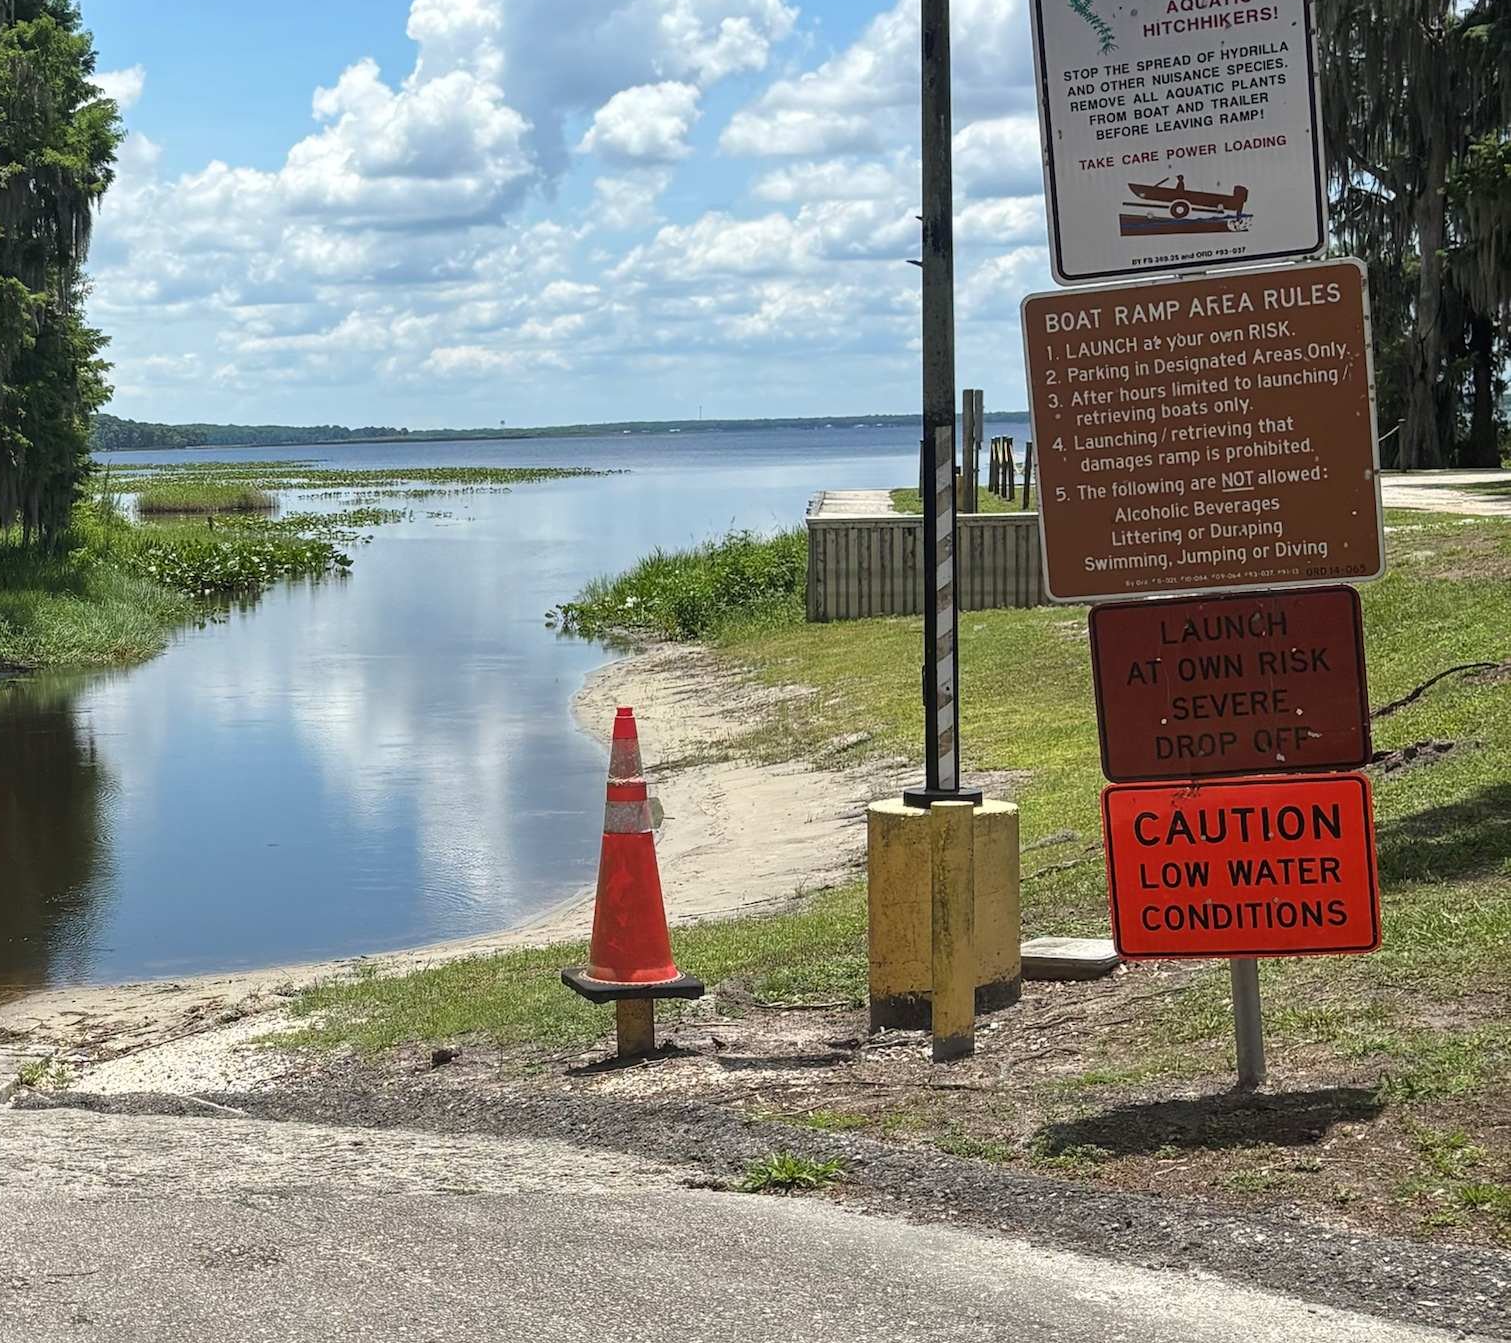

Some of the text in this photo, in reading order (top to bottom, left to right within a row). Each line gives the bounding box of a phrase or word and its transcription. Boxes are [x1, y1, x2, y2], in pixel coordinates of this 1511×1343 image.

[1143, 7, 1279, 37] HITCHHIKERS!
[1064, 41, 1289, 82] STOP THE SPREAD OF HYDRILLA
[1068, 59, 1288, 97] AND OTHER NUISANCE SPECIES.
[1070, 74, 1286, 111] REMOVE ALL AQUATIC PLANTS
[1090, 92, 1269, 125] FROM BOAT AND TRAILER
[1096, 110, 1264, 140] BEFORE LEAVING RAMP!
[1080, 135, 1286, 170] TAKE CARE POWER LOADING
[1045, 283, 1341, 333] BOAT RAMP AREA RULES
[1047, 322, 1295, 360] 1. LAUNCH at your own RISK.
[1046, 342, 1350, 385] 2. Parking in Designated Areas Only.
[1049, 393, 1063, 407] 3.
[1071, 390, 1113, 407] After
[1120, 385, 1166, 402] hours
[1172, 379, 1227, 397] limited
[1234, 376, 1251, 390] to
[1258, 368, 1338, 392] launching
[1077, 398, 1253, 427] retrieving boats only.
[1052, 437, 1066, 452] 4.
[1258, 417, 1293, 432] that
[1081, 439, 1313, 473] damages ramp is prohibited.
[1056, 467, 1328, 501] 5. The following are NOT allowed:
[1115, 497, 1280, 523] Alcoholic Beverages
[1112, 527, 1182, 546] Littering
[1188, 527, 1205, 540] or
[1084, 542, 1328, 571] Swimming, Jumping or Diving
[1161, 613, 1288, 644] LAUNCH
[1127, 649, 1331, 685] AT OWN RISK
[1172, 690, 1290, 721] SEVERE
[1156, 727, 1309, 760] DROP OFF
[1134, 804, 1341, 846] CAUTION
[1140, 858, 1341, 889] LOW WATER
[1142, 901, 1347, 931] CONDITIONS
